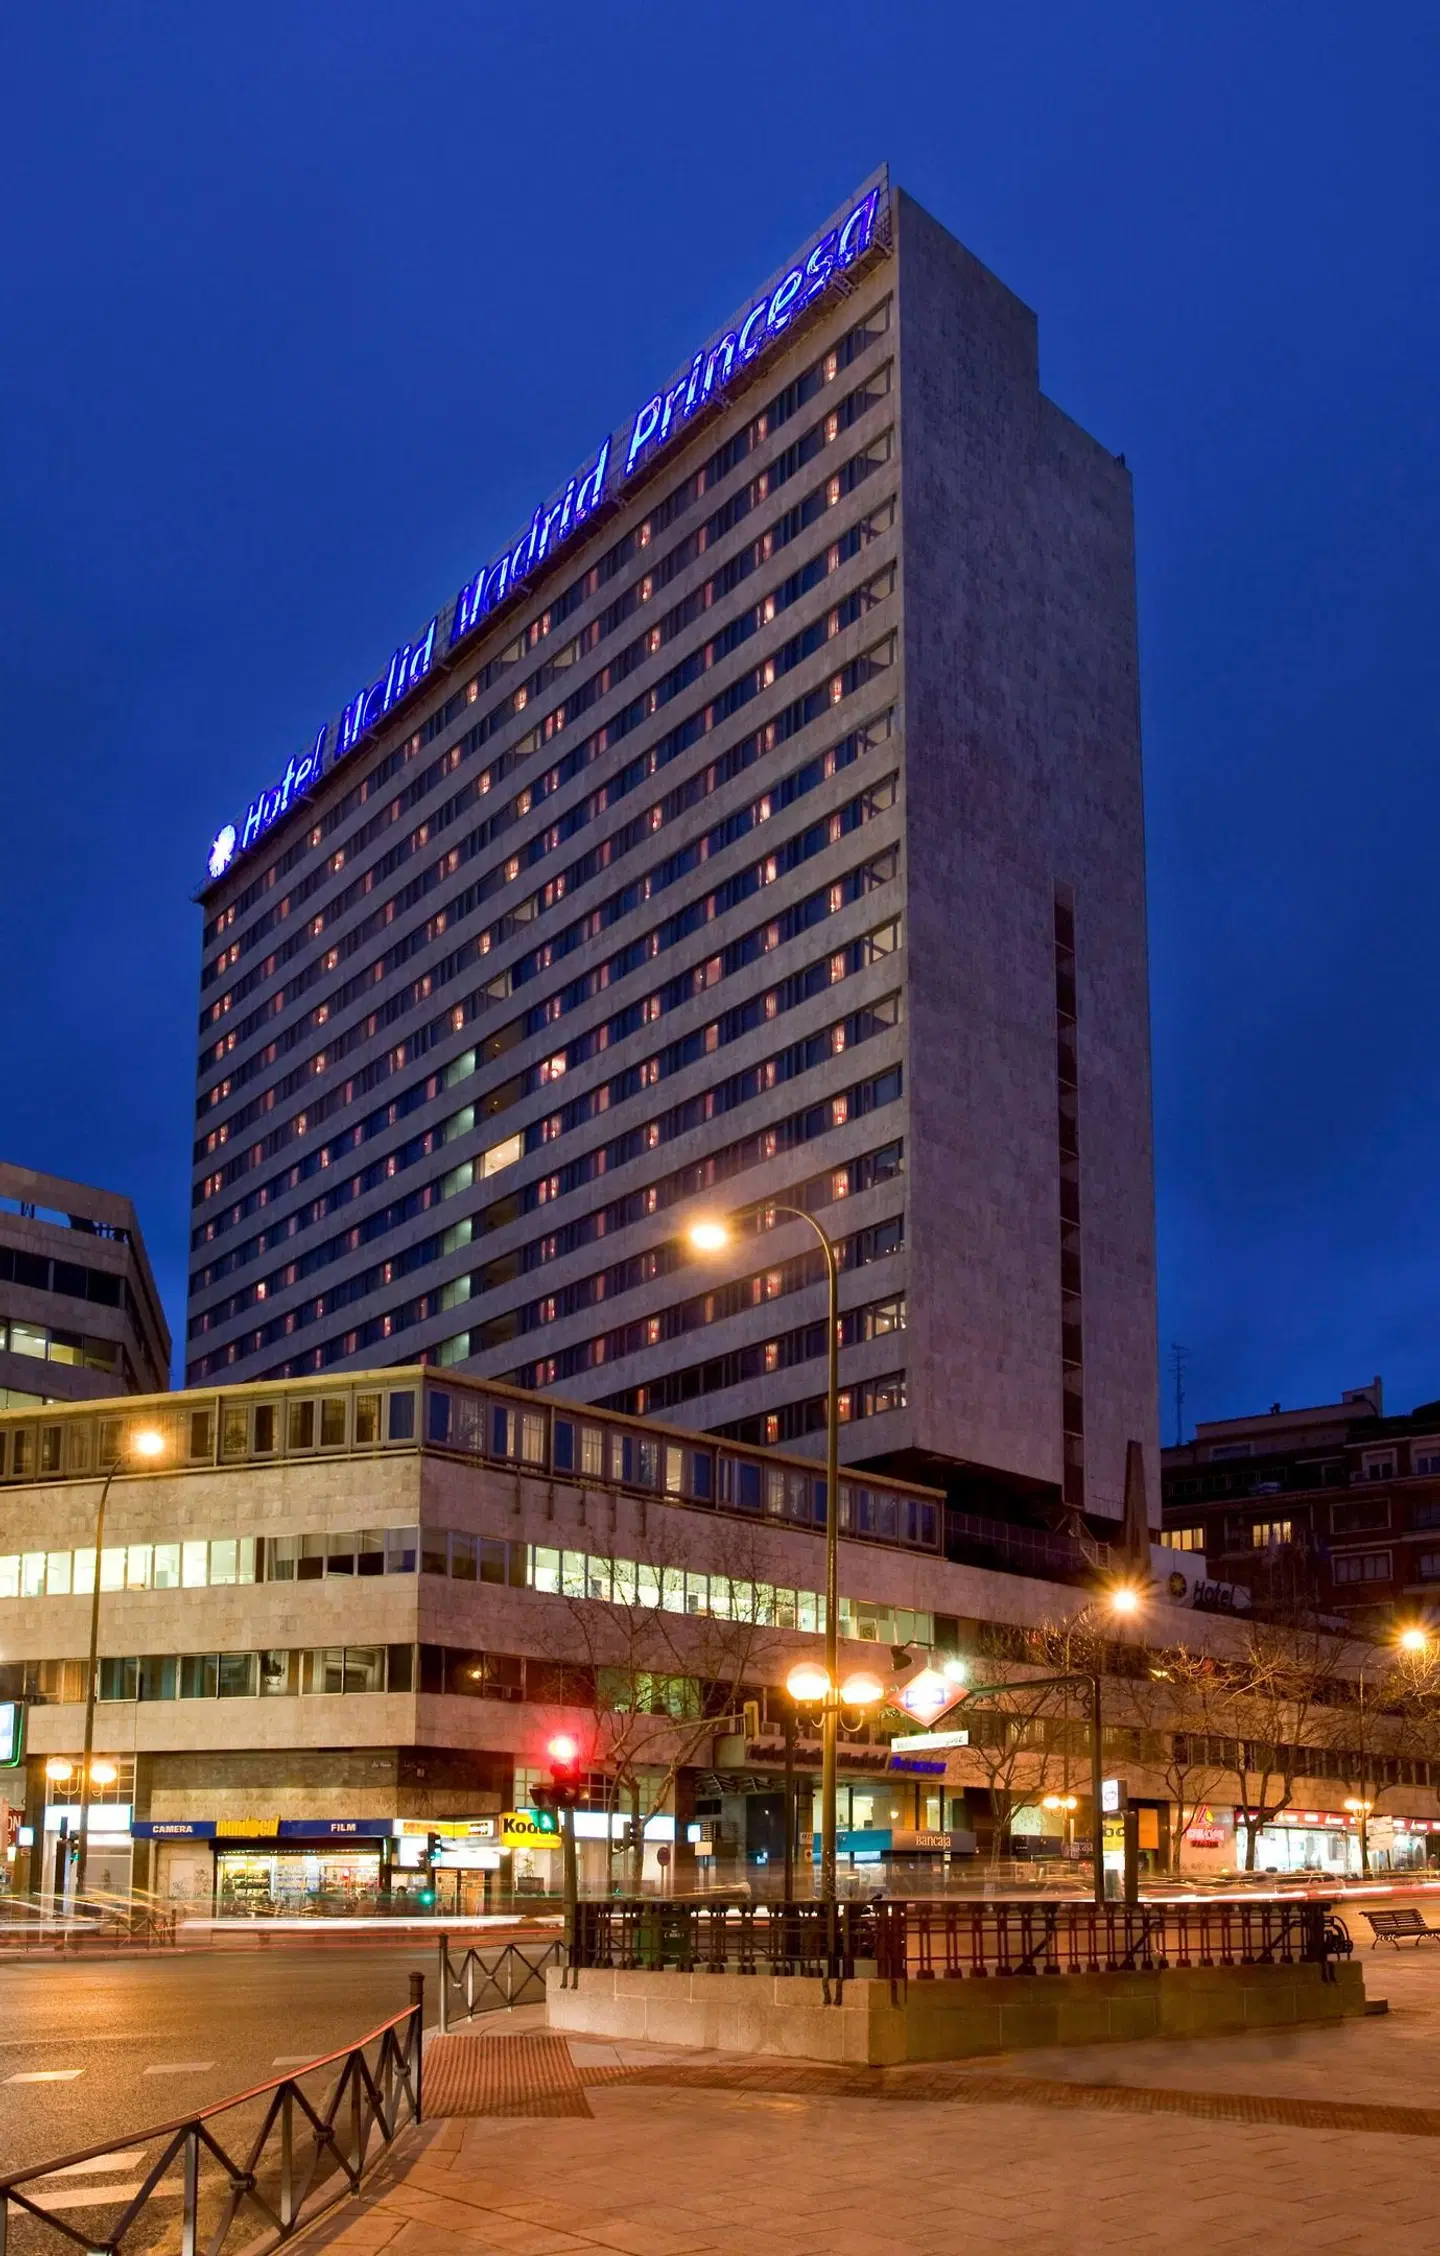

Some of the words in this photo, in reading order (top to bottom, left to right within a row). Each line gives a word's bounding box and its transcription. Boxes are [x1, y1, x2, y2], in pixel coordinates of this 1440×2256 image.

[240, 722, 328, 851] Hotel
[624, 185, 880, 477] Princesa
[1194, 1579, 1235, 1608] Hotel
[152, 1825, 193, 1834] CAMERA
[330, 1823, 356, 1832] FILM
[503, 1818, 559, 1834] Kod
[915, 1832, 952, 1850] Bancaja
